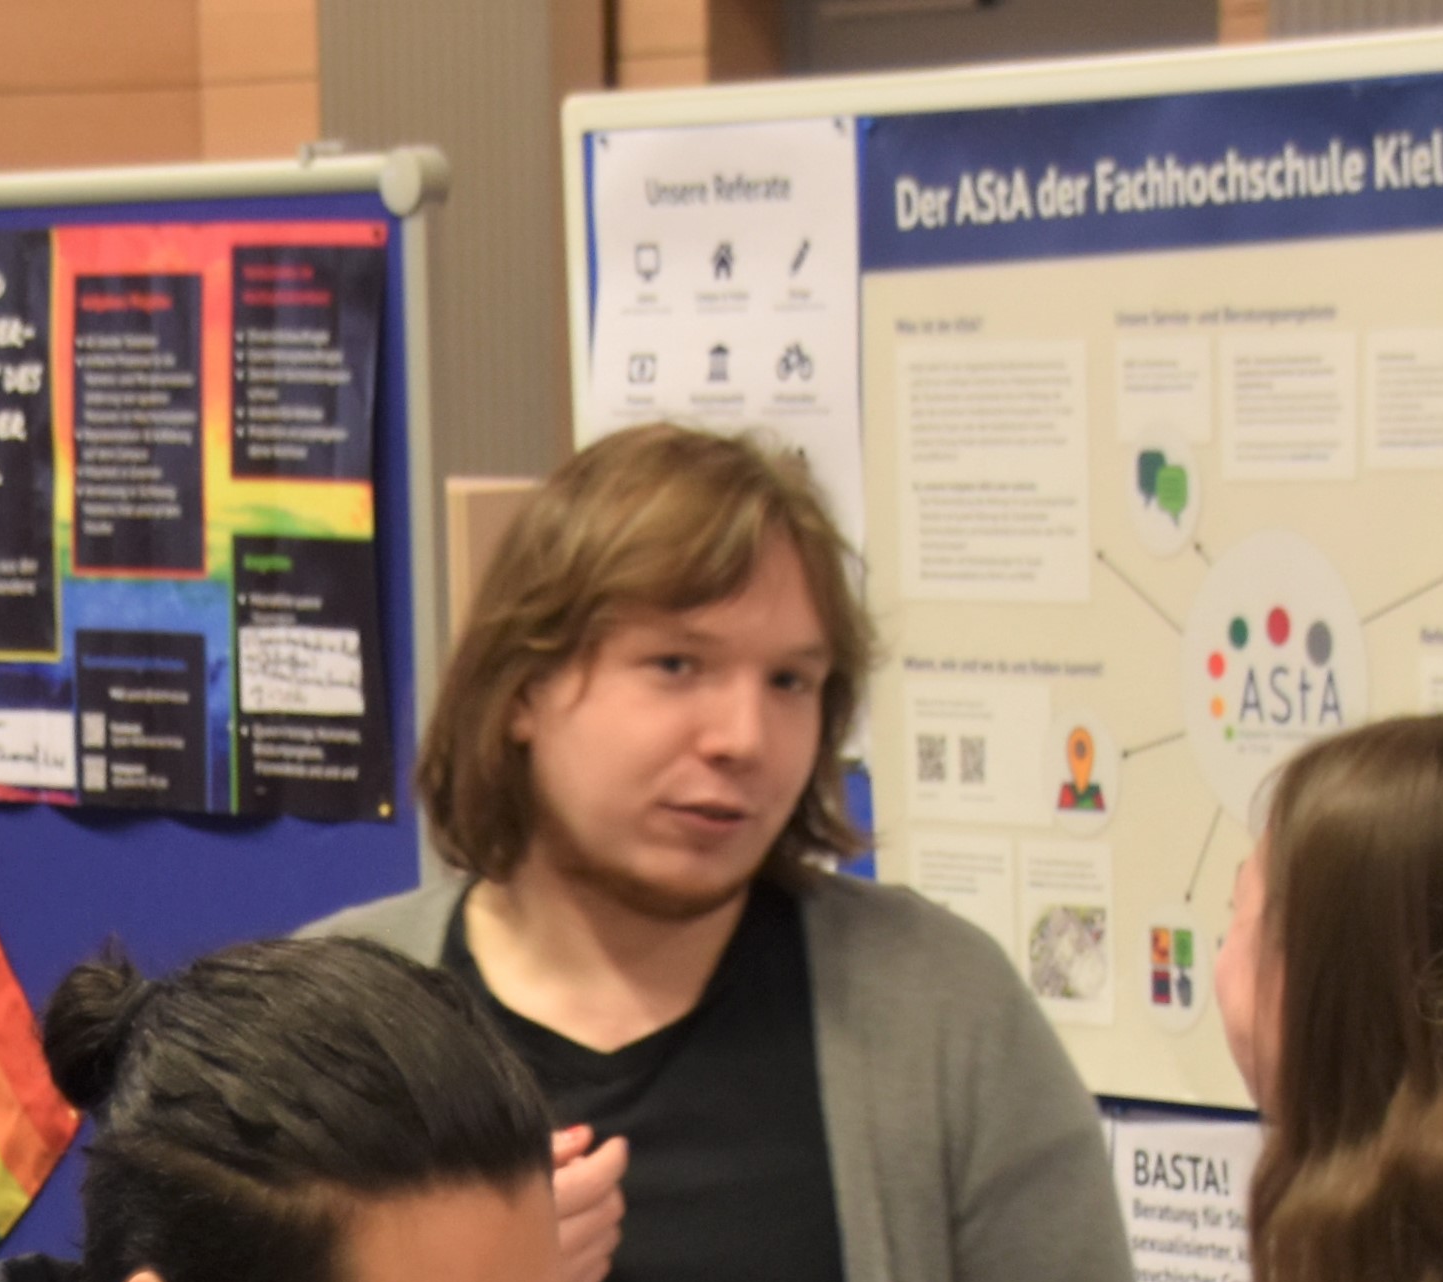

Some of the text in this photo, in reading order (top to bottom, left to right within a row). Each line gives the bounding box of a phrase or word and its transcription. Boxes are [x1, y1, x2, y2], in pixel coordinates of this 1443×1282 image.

[645, 170, 792, 207] Unsere Referate
[894, 174, 950, 232] Der
[956, 167, 1032, 226] AStA
[1037, 163, 1090, 221] der
[1094, 136, 1367, 214] Fachhochschule
[1239, 665, 1343, 727] AStA
[1133, 1149, 1230, 1197] BASTA!
[1132, 1198, 1198, 1230] Beratung
